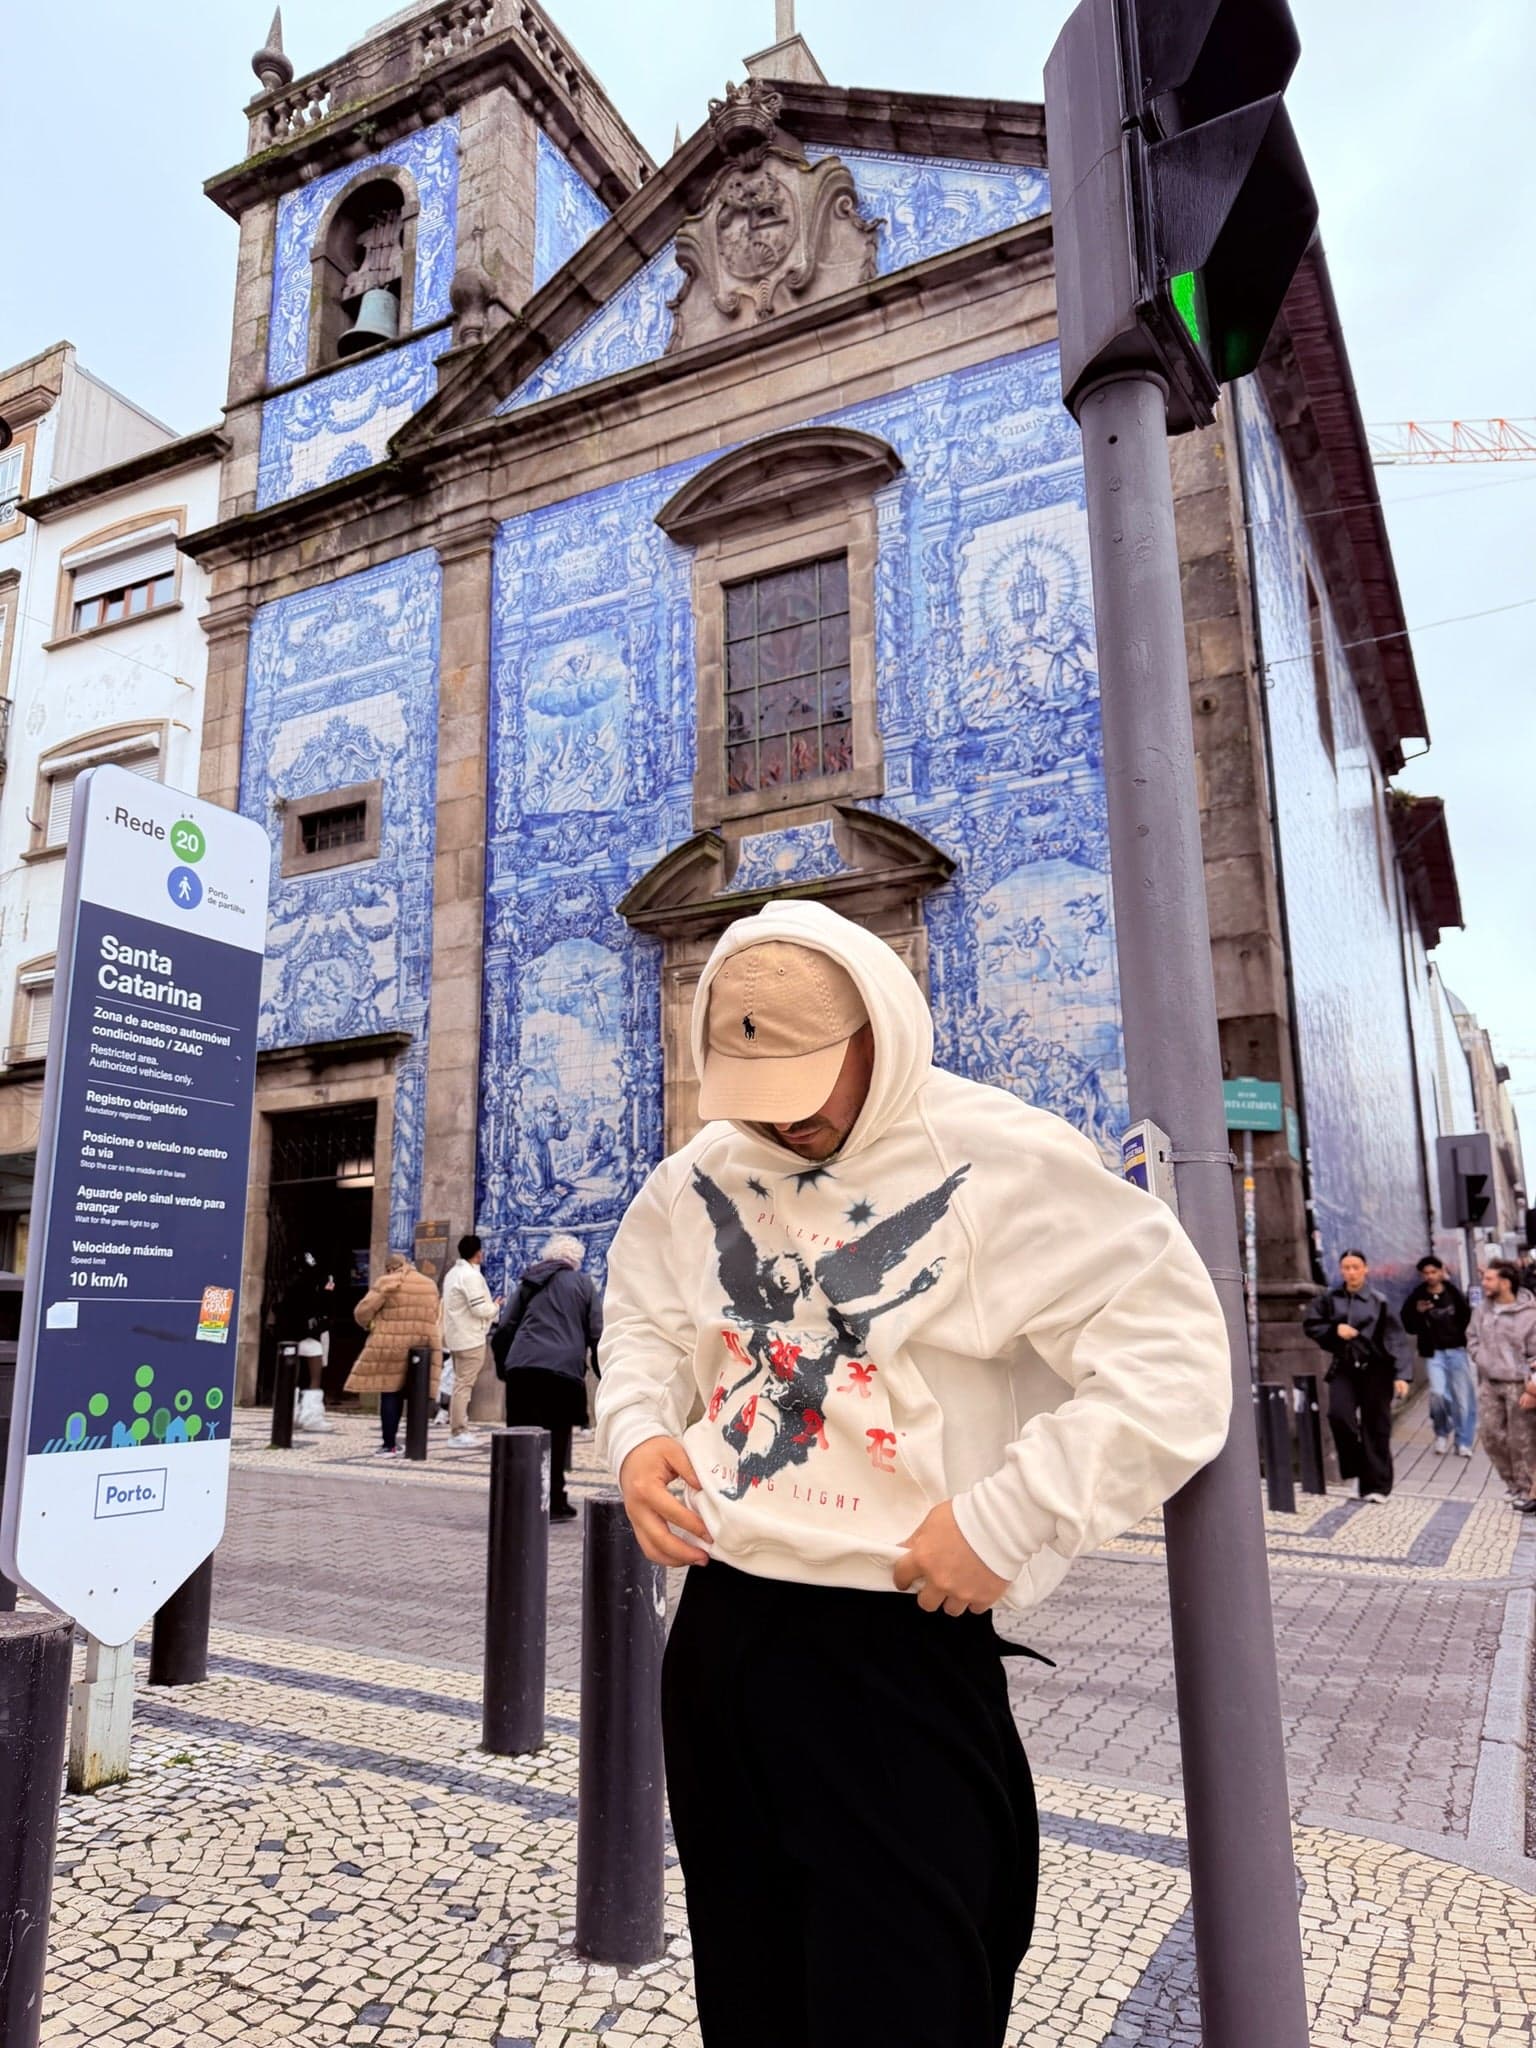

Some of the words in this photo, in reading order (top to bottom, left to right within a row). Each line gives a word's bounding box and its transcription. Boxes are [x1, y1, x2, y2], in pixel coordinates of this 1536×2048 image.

[114, 806, 165, 840] Rede
[176, 830, 199, 853] 20
[208, 886, 229, 900] Porto
[207, 897, 217, 906] de
[218, 901, 245, 914] partilha
[100, 935, 173, 976] Santa
[98, 964, 202, 1011] Catarina
[93, 1006, 122, 1023] Zona
[125, 1014, 139, 1026] de
[141, 1019, 178, 1035] acesso
[180, 1027, 231, 1046] automóvel
[92, 1025, 165, 1049] condicionado
[166, 1039, 173, 1050] /
[173, 1041, 204, 1056] ZAAC
[90, 1043, 136, 1061] Restricted
[137, 1054, 159, 1065] area.
[89, 1057, 137, 1074] Authorized
[139, 1066, 173, 1081] vehicles
[174, 1073, 194, 1086] only.
[85, 1105, 118, 1118] Mandatory
[119, 1109, 152, 1121] registration
[86, 1090, 131, 1108] Registro
[133, 1098, 188, 1116] obrigatório
[81, 1145, 96, 1157] da
[98, 1147, 114, 1159] via
[82, 1130, 135, 1147] Posicione
[136, 1139, 144, 1148] o
[146, 1139, 181, 1154] veículo
[183, 1145, 196, 1155] no
[197, 1147, 228, 1160] centro
[80, 1159, 96, 1170] Stop
[96, 1162, 107, 1170] the
[107, 1163, 118, 1171] car
[125, 1165, 135, 1173] the
[136, 1166, 156, 1176] middle
[156, 1168, 163, 1176] of
[163, 1169, 174, 1177] the
[77, 1185, 123, 1200] Aguarde
[125, 1190, 148, 1203] pelo
[149, 1192, 173, 1204] sinal
[175, 1195, 202, 1207] verde
[203, 1200, 226, 1210] para
[76, 1201, 120, 1216] avançar
[75, 1215, 90, 1224] Wait
[90, 1216, 99, 1225] for
[100, 1217, 110, 1225] the
[111, 1219, 129, 1228] green
[129, 1219, 142, 1229] light
[143, 1220, 150, 1228] to
[150, 1221, 160, 1231] go
[72, 1239, 131, 1255] Velocidade
[133, 1243, 174, 1257] máxima
[71, 1256, 92, 1266] Speed
[93, 1256, 106, 1266] limit
[70, 1271, 88, 1287] 10
[91, 1272, 129, 1288] km/h
[106, 1484, 157, 1504] Porto.
[793, 1484, 861, 1511] LIGHT
